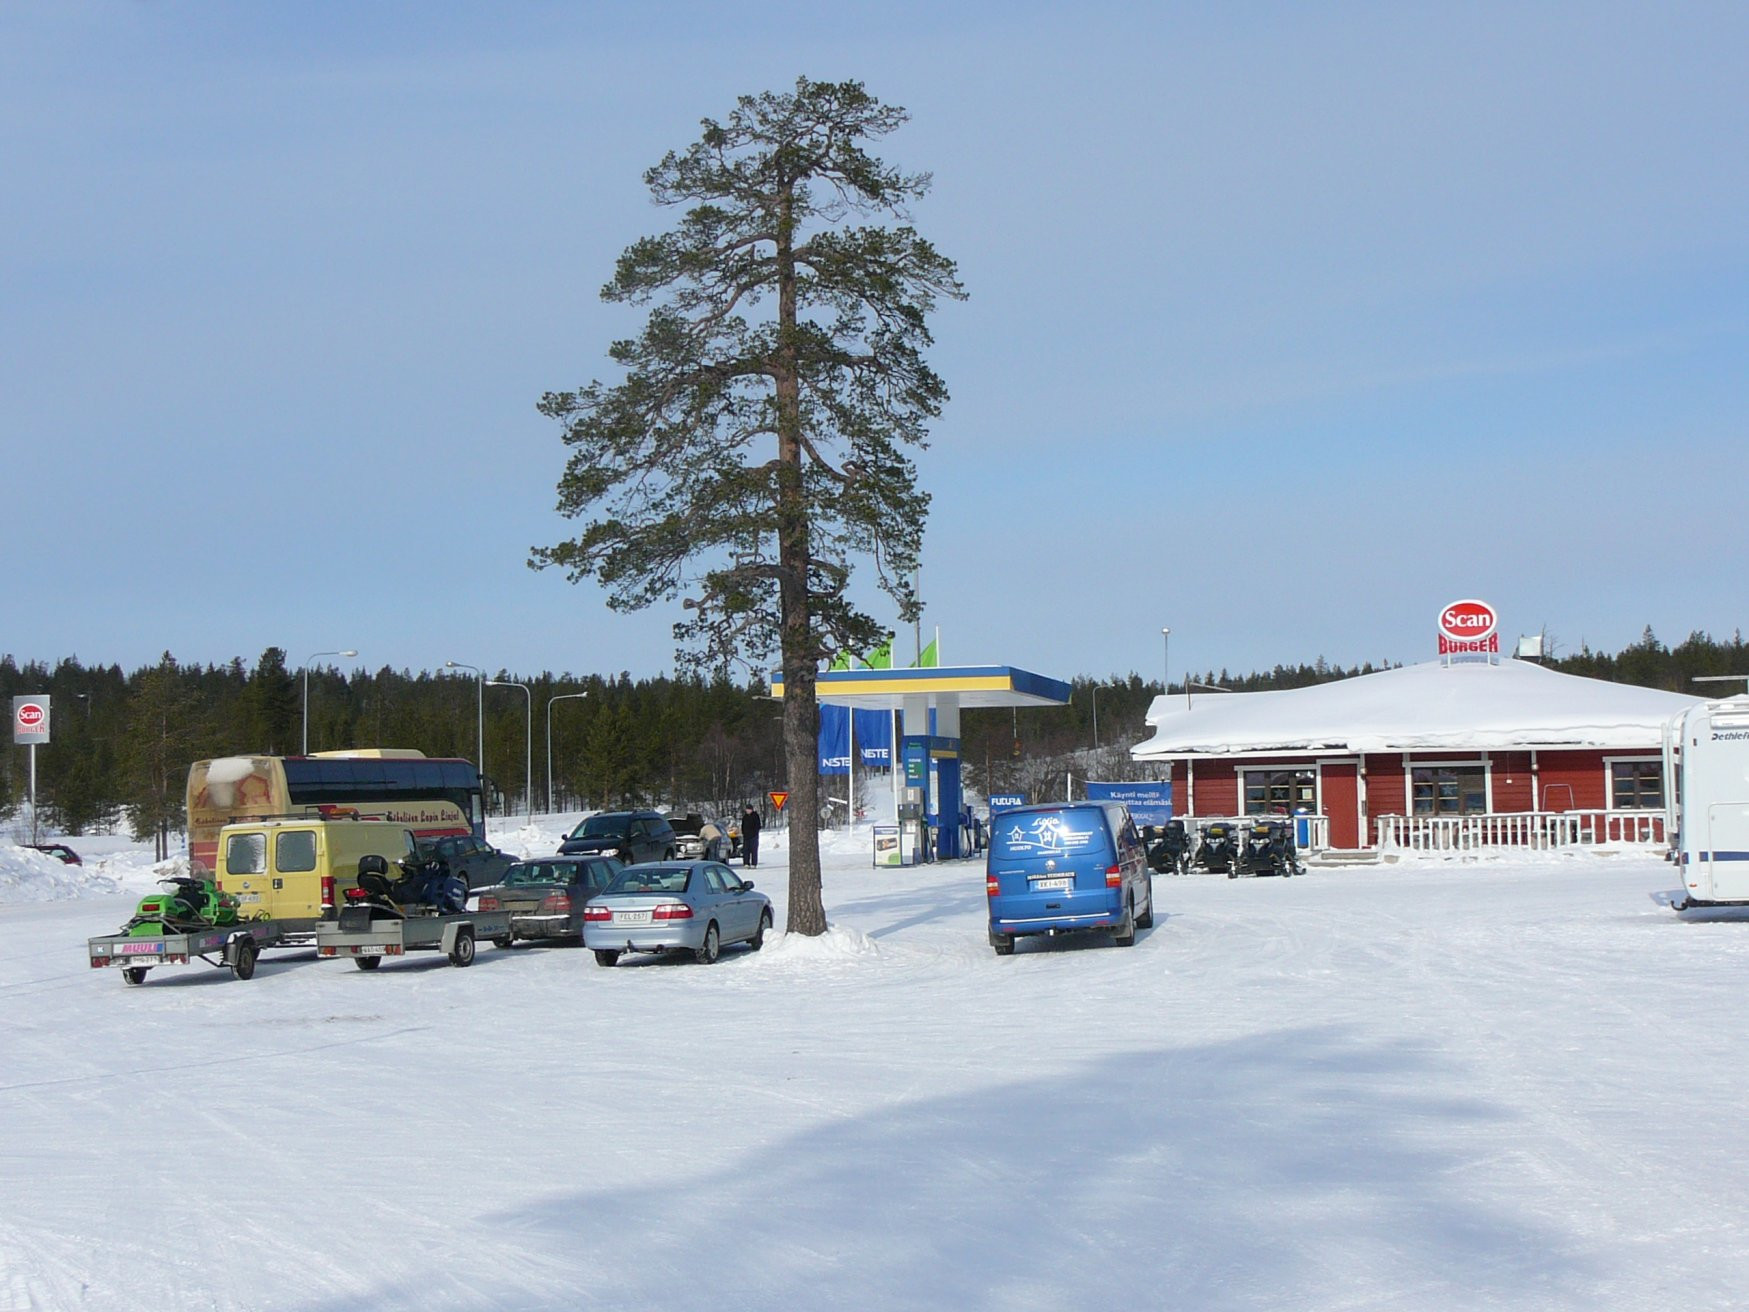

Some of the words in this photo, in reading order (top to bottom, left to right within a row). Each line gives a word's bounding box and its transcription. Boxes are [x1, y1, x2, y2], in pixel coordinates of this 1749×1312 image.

[1445, 610, 1490, 627] Scan
[1438, 632, 1498, 655] BURGER
[20, 709, 41, 720] Scan
[1711, 731, 1749, 741] Dethlef
[991, 797, 1022, 806] FUTURA
